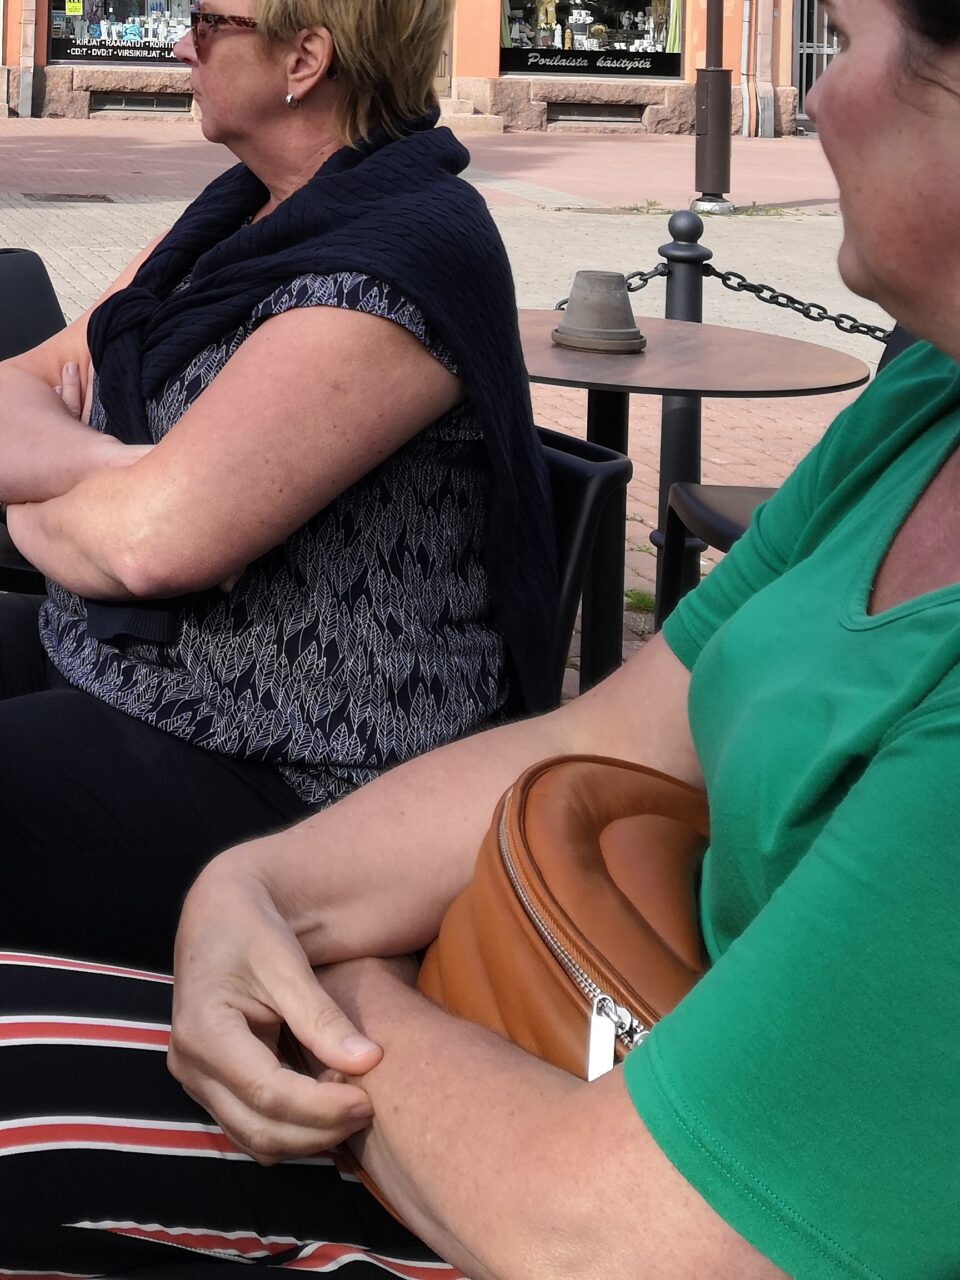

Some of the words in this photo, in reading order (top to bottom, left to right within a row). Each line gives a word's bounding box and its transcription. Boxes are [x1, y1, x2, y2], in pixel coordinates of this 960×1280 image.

[76, 38, 101, 46] KIRJAT
[105, 39, 145, 48] RAAMATUT
[91, 49, 114, 57] DVD:T
[117, 49, 161, 58] VIRSIKIRJAT
[527, 52, 590, 67] Porilaista
[596, 55, 652, 71] käsityötä
